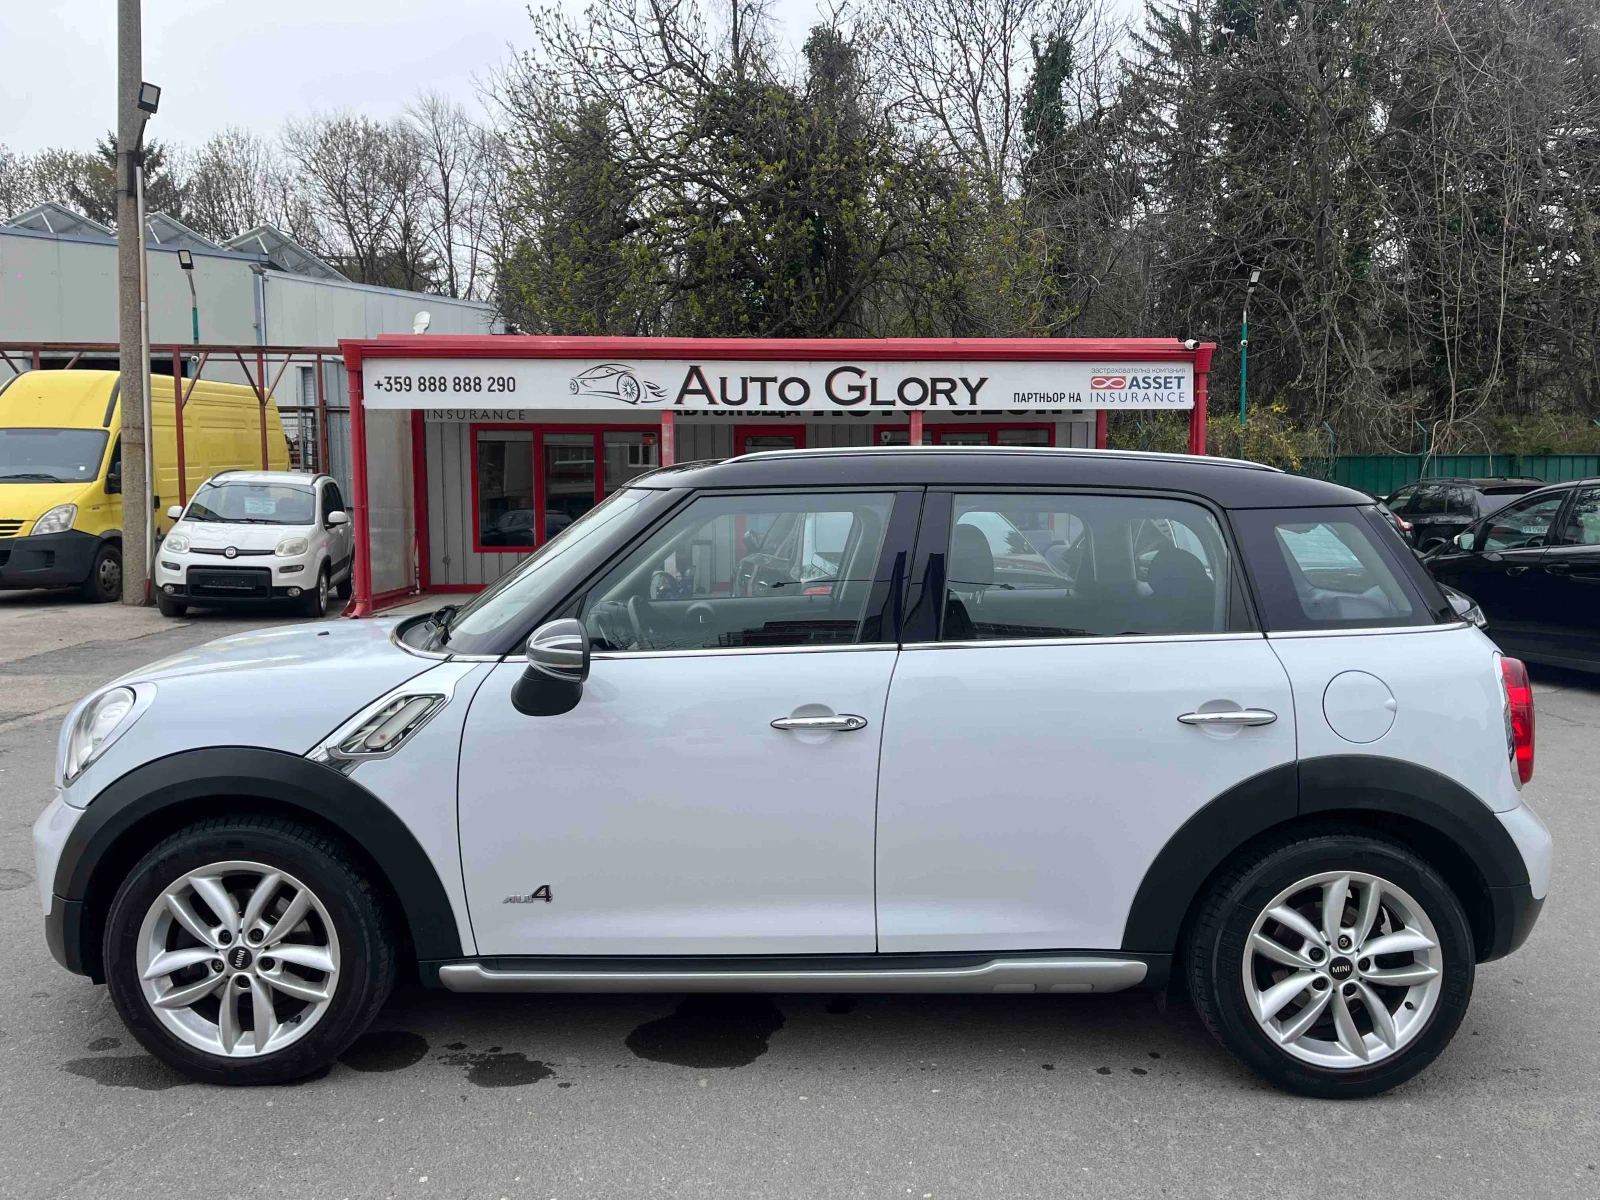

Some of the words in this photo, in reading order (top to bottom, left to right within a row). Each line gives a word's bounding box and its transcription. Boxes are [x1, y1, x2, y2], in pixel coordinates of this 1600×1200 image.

[374, 376, 412, 393] +359
[417, 376, 448, 393] 888
[452, 376, 482, 393] 888
[487, 376, 516, 393] 290
[1128, 376, 1185, 389] ASSET
[1013, 392, 1066, 403] ПАРТНЬОР
[1068, 392, 1082, 403] НА
[1090, 392, 1185, 402] INSURANCE
[426, 409, 526, 420] INSURANCE
[235, 949, 246, 967] MINI
[1332, 964, 1350, 973] MINI
